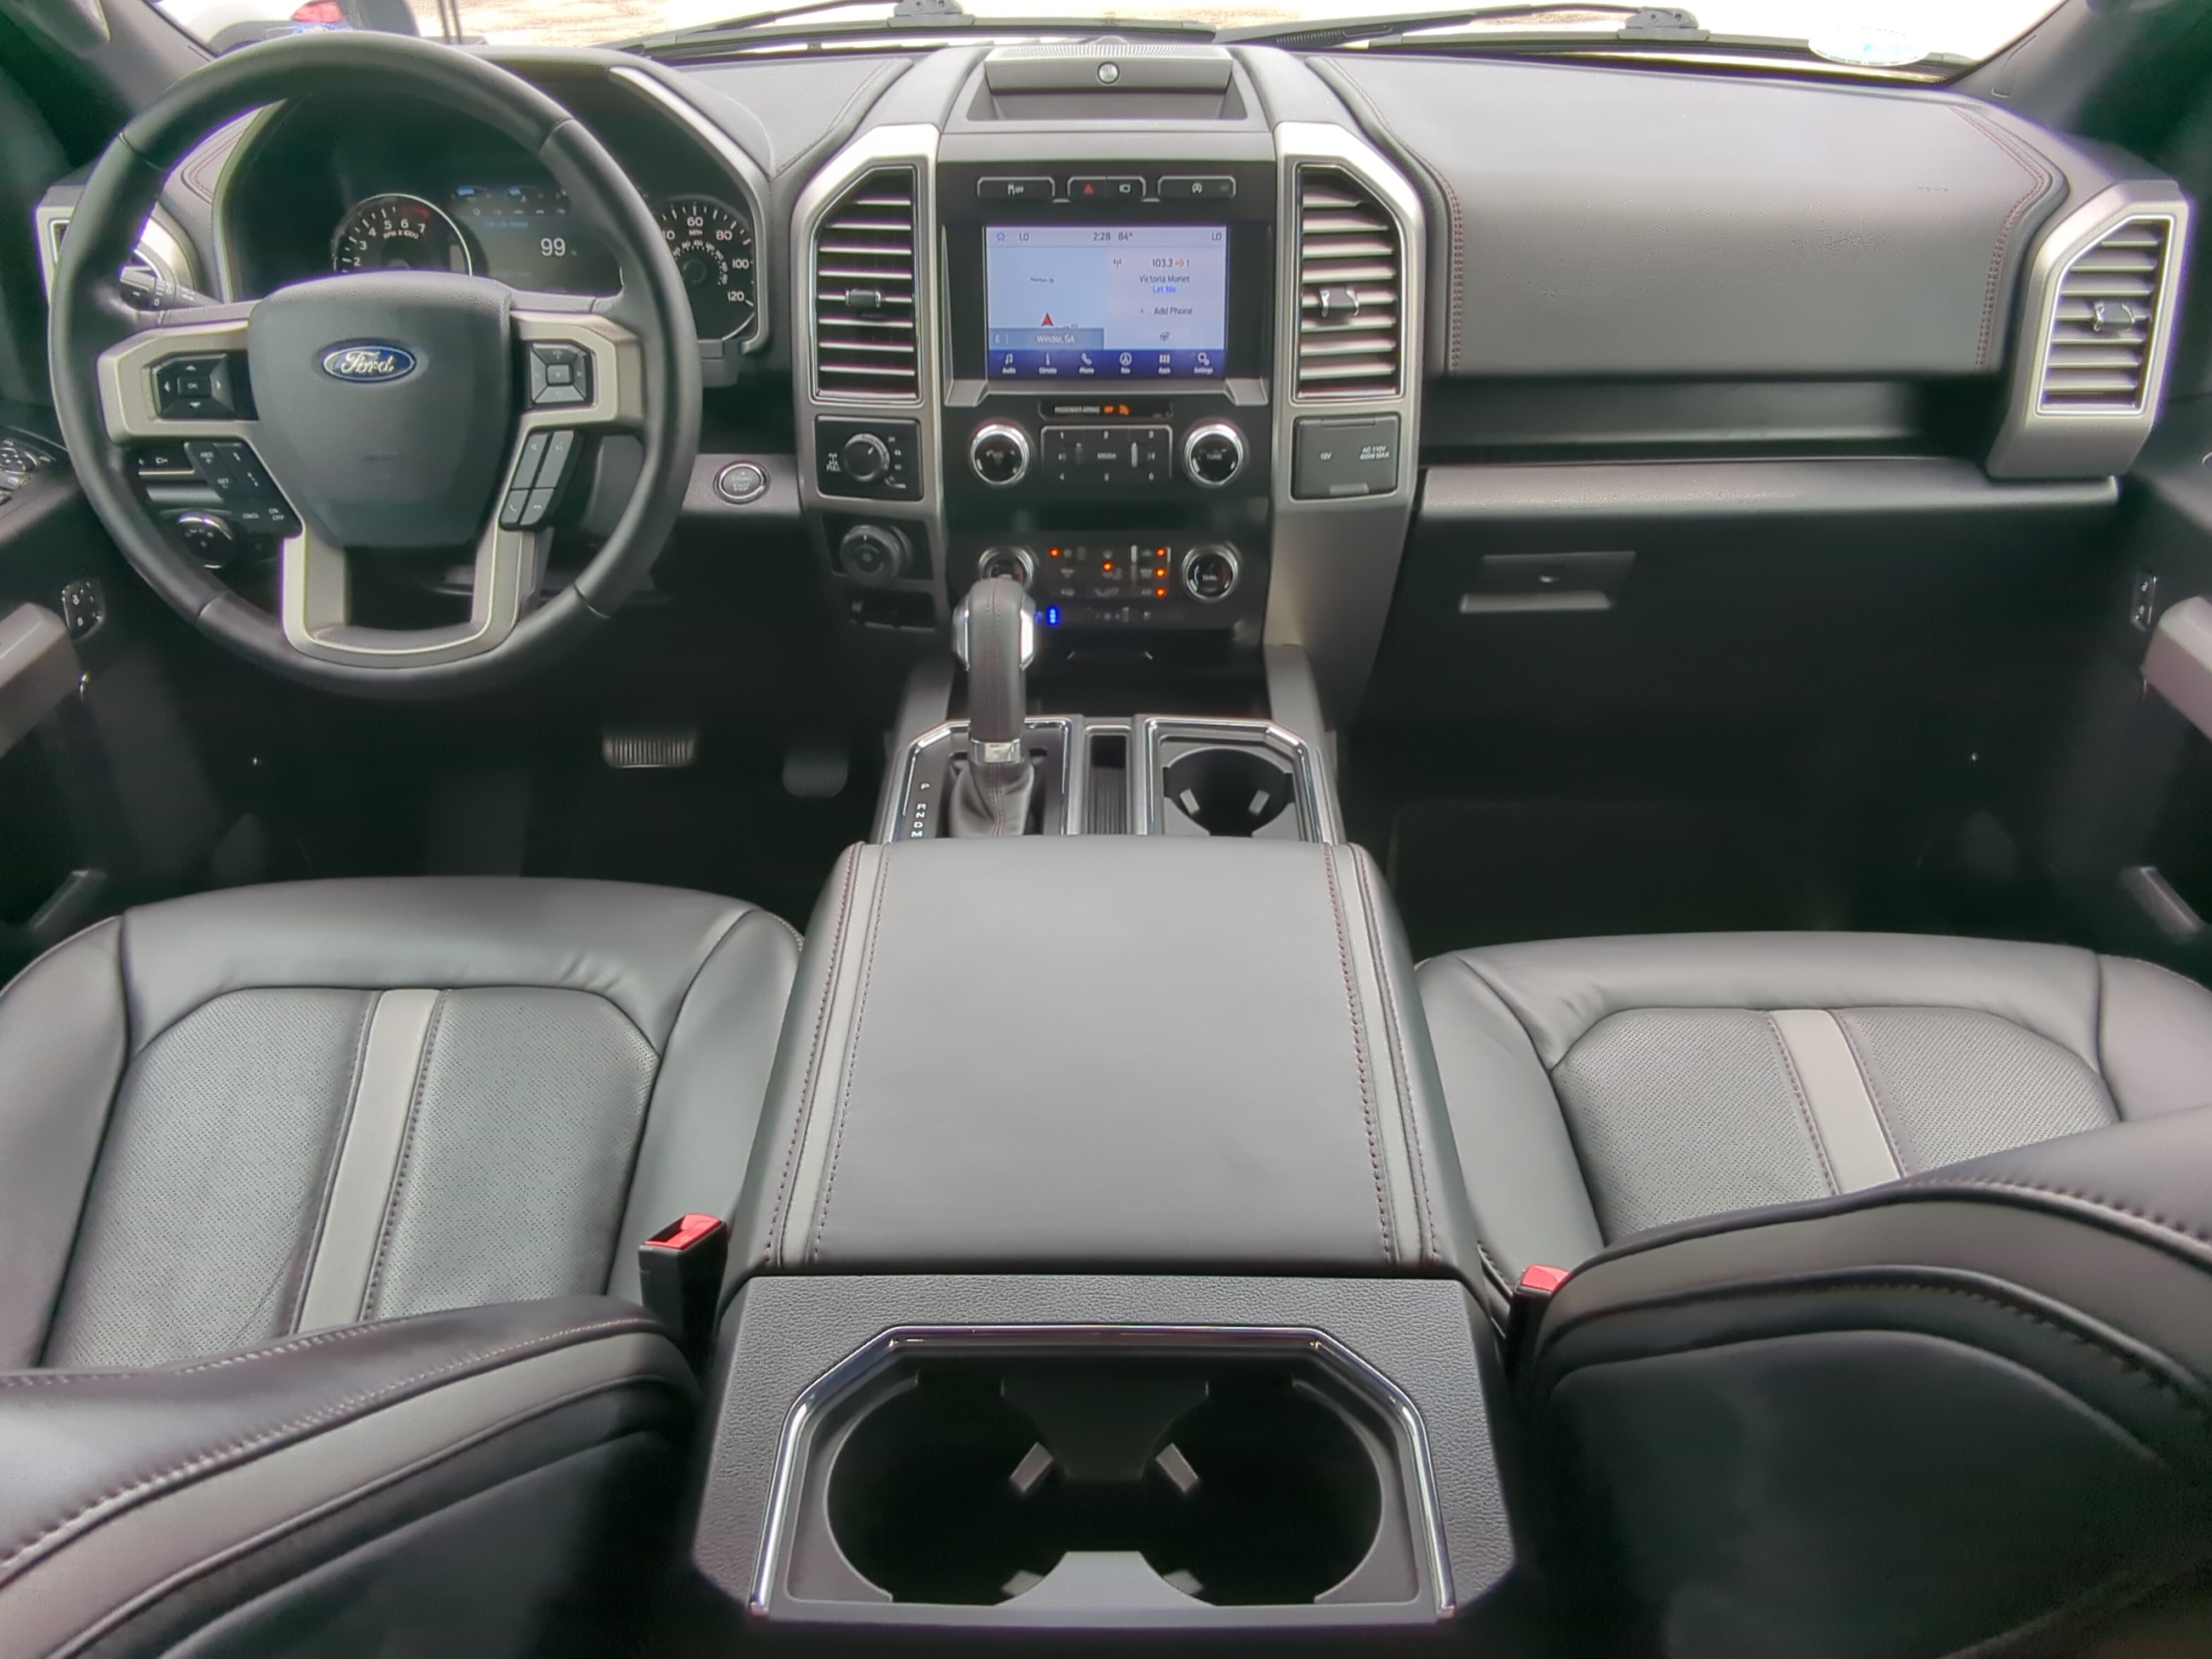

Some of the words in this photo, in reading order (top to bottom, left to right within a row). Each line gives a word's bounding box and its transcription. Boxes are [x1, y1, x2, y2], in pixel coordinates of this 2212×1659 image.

[385, 221, 392, 229] 5
[401, 219, 409, 228] 6
[687, 217, 703, 227] 60
[369, 228, 376, 237] 4
[419, 224, 426, 233] 7
[716, 230, 732, 240] 80
[1019, 233, 1029, 241] LO
[1093, 232, 1111, 241] 2:28
[1211, 233, 1222, 241] LO
[360, 241, 367, 250] 3
[540, 238, 566, 256] 99
[353, 257, 361, 266] 2
[732, 258, 749, 269] 100
[1152, 259, 1173, 268] 103.3
[728, 291, 744, 301] 120
[1064, 335, 1075, 344] GA
[341, 351, 394, 374] Ford
